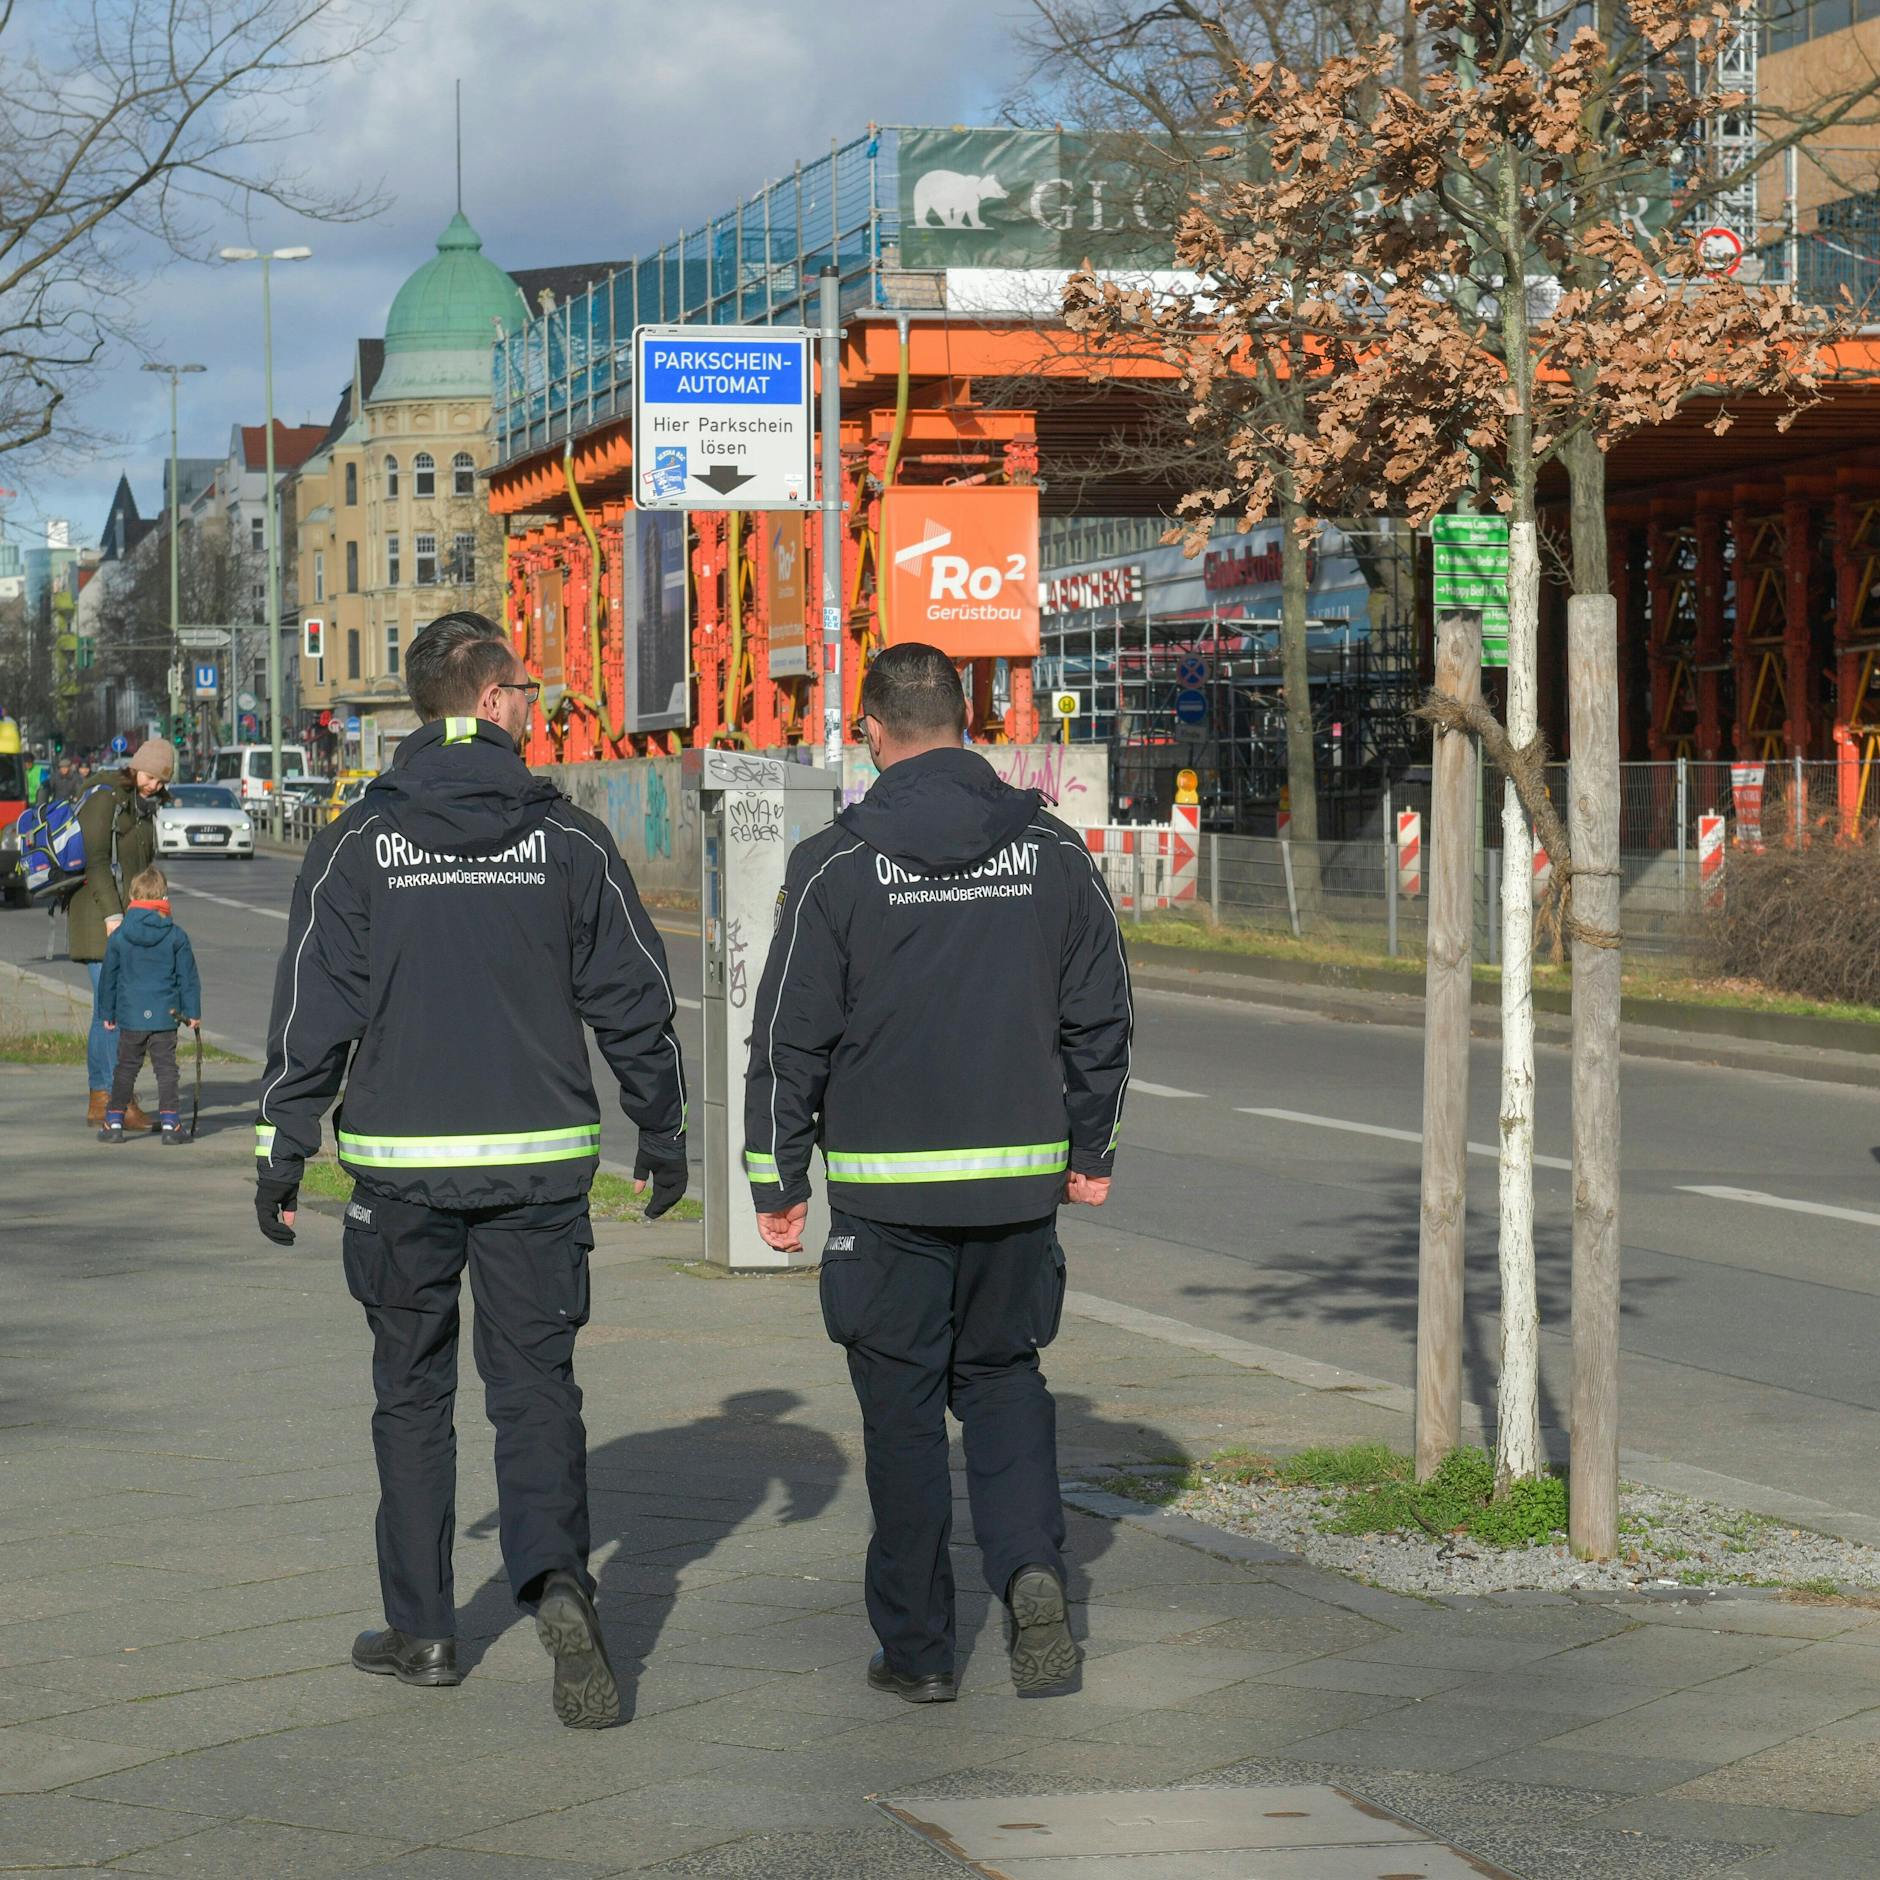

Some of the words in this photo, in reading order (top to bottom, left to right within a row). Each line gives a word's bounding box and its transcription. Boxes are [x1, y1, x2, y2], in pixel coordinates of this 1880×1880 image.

[654, 352, 792, 370] PARKSCHEIN-
[677, 376, 770, 394] AUTOMAT
[654, 417, 690, 431] Hier
[699, 418, 793, 433] Parkschein
[701, 440, 747, 455] lösen
[927, 604, 1021, 620] Gerüstbau
[199, 668, 213, 686] U
[388, 869, 546, 889] PARKRAUMÜBERWACHUNG
[889, 884, 1033, 906] PARKRAUMÜBERWACHUN
